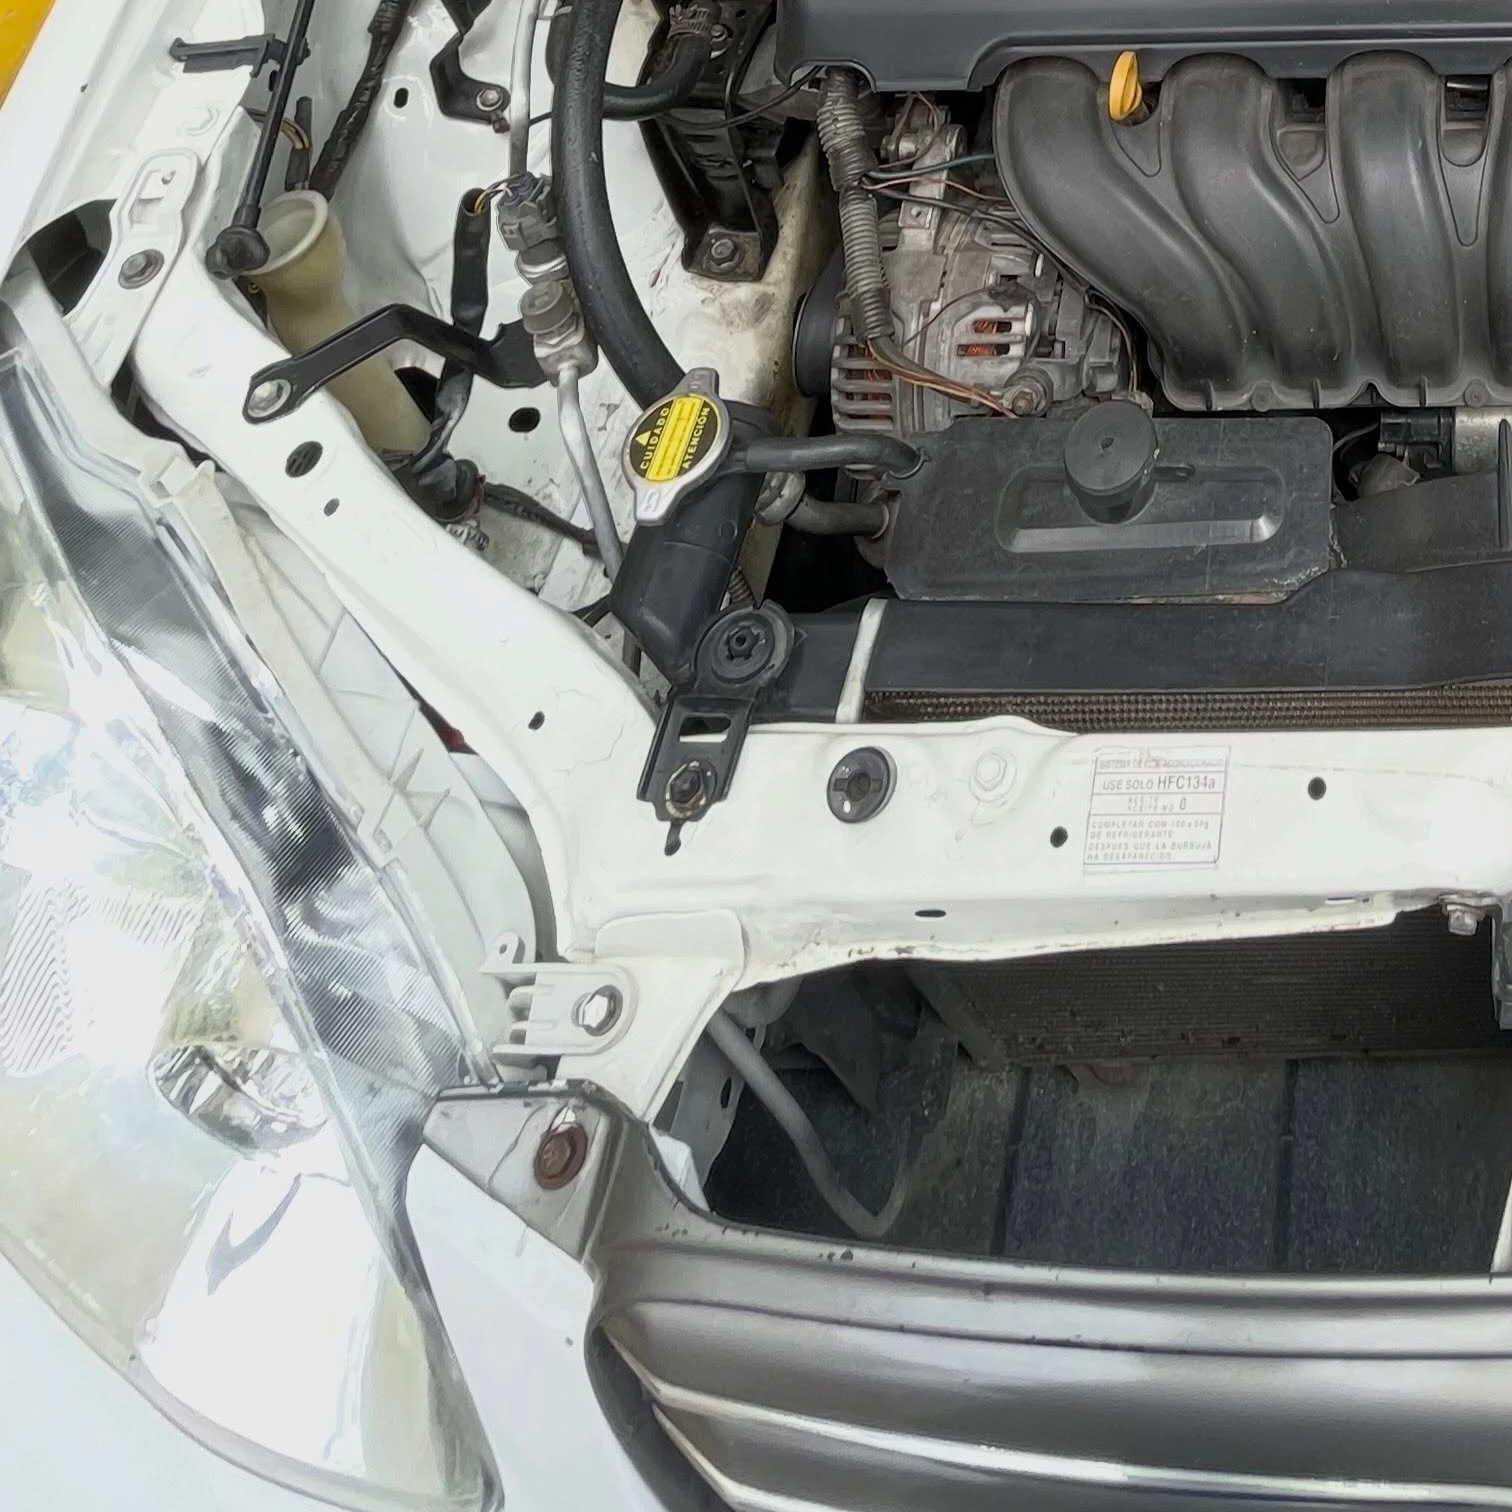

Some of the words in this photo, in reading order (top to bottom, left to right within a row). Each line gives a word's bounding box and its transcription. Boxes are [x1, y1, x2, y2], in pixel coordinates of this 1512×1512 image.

[640, 407, 669, 469] CUIDADO
[1102, 778, 1123, 791] USE
[1125, 778, 1154, 790] SOLO
[1157, 775, 1216, 790] HFC134a
